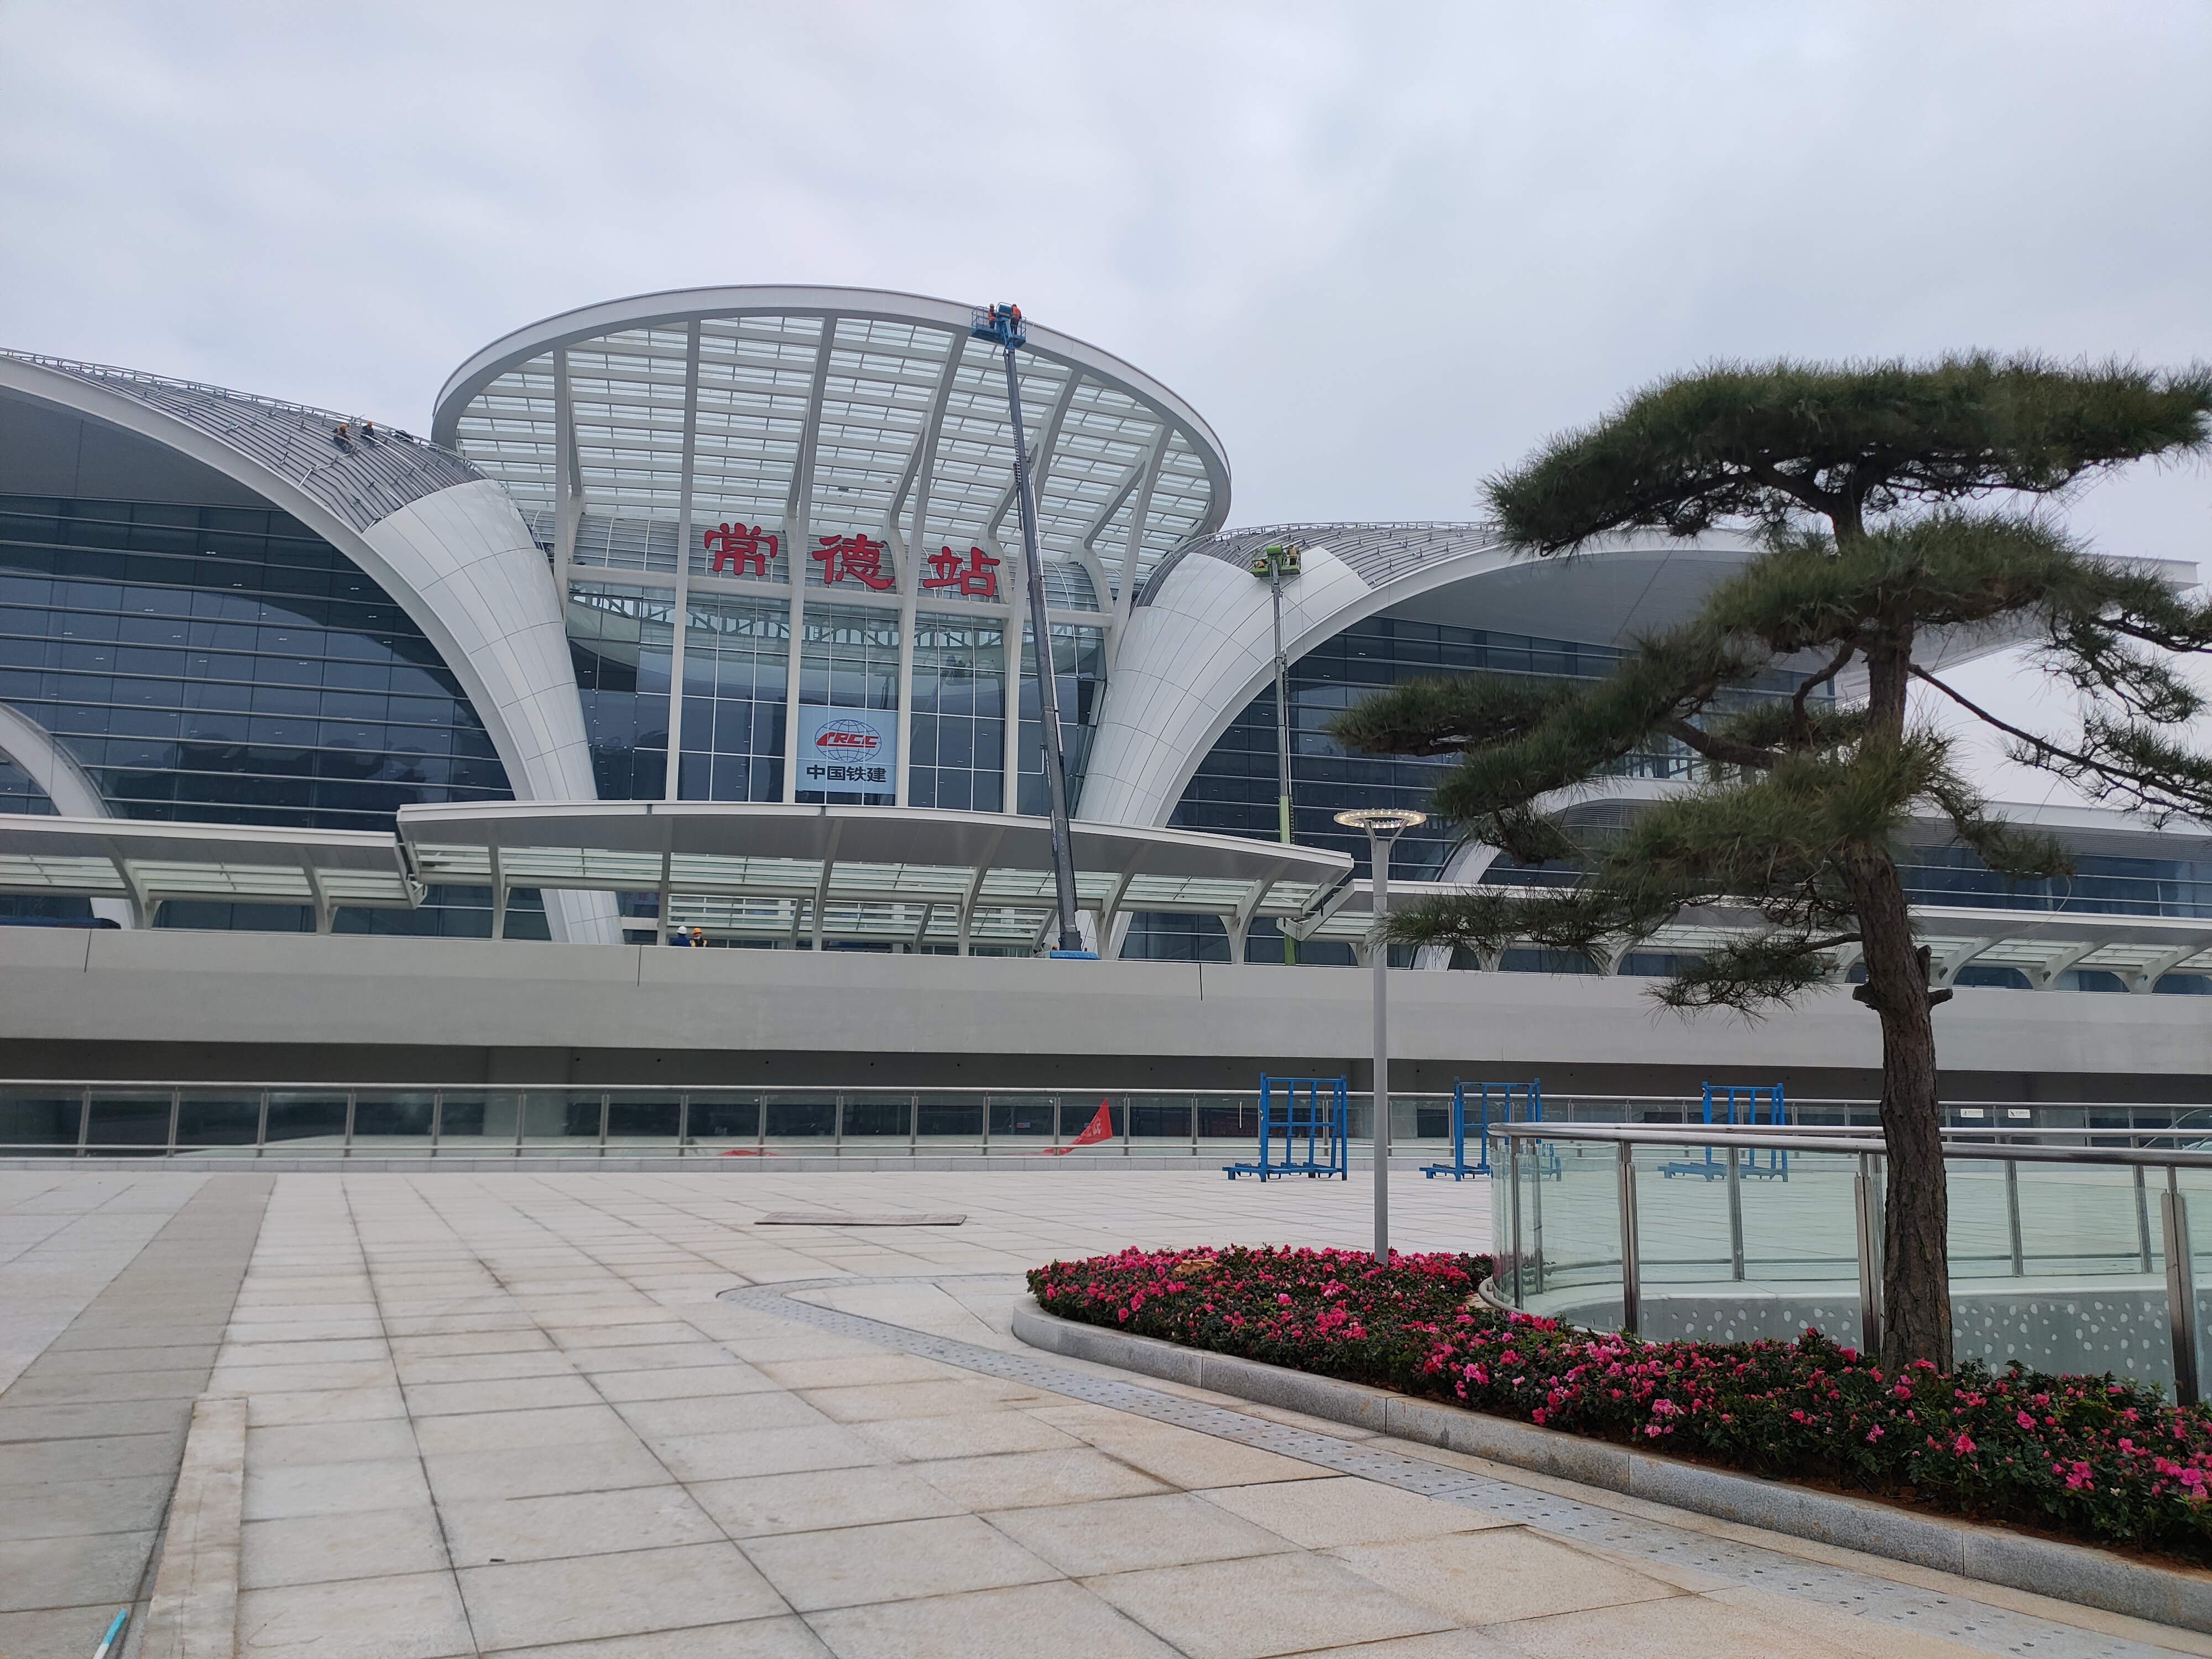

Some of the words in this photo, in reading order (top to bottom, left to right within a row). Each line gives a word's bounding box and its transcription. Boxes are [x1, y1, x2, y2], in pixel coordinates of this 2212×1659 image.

[704, 523, 1000, 597] 常德站
[816, 732, 879, 748] CRCC
[806, 765, 886, 782] 中国铁建
